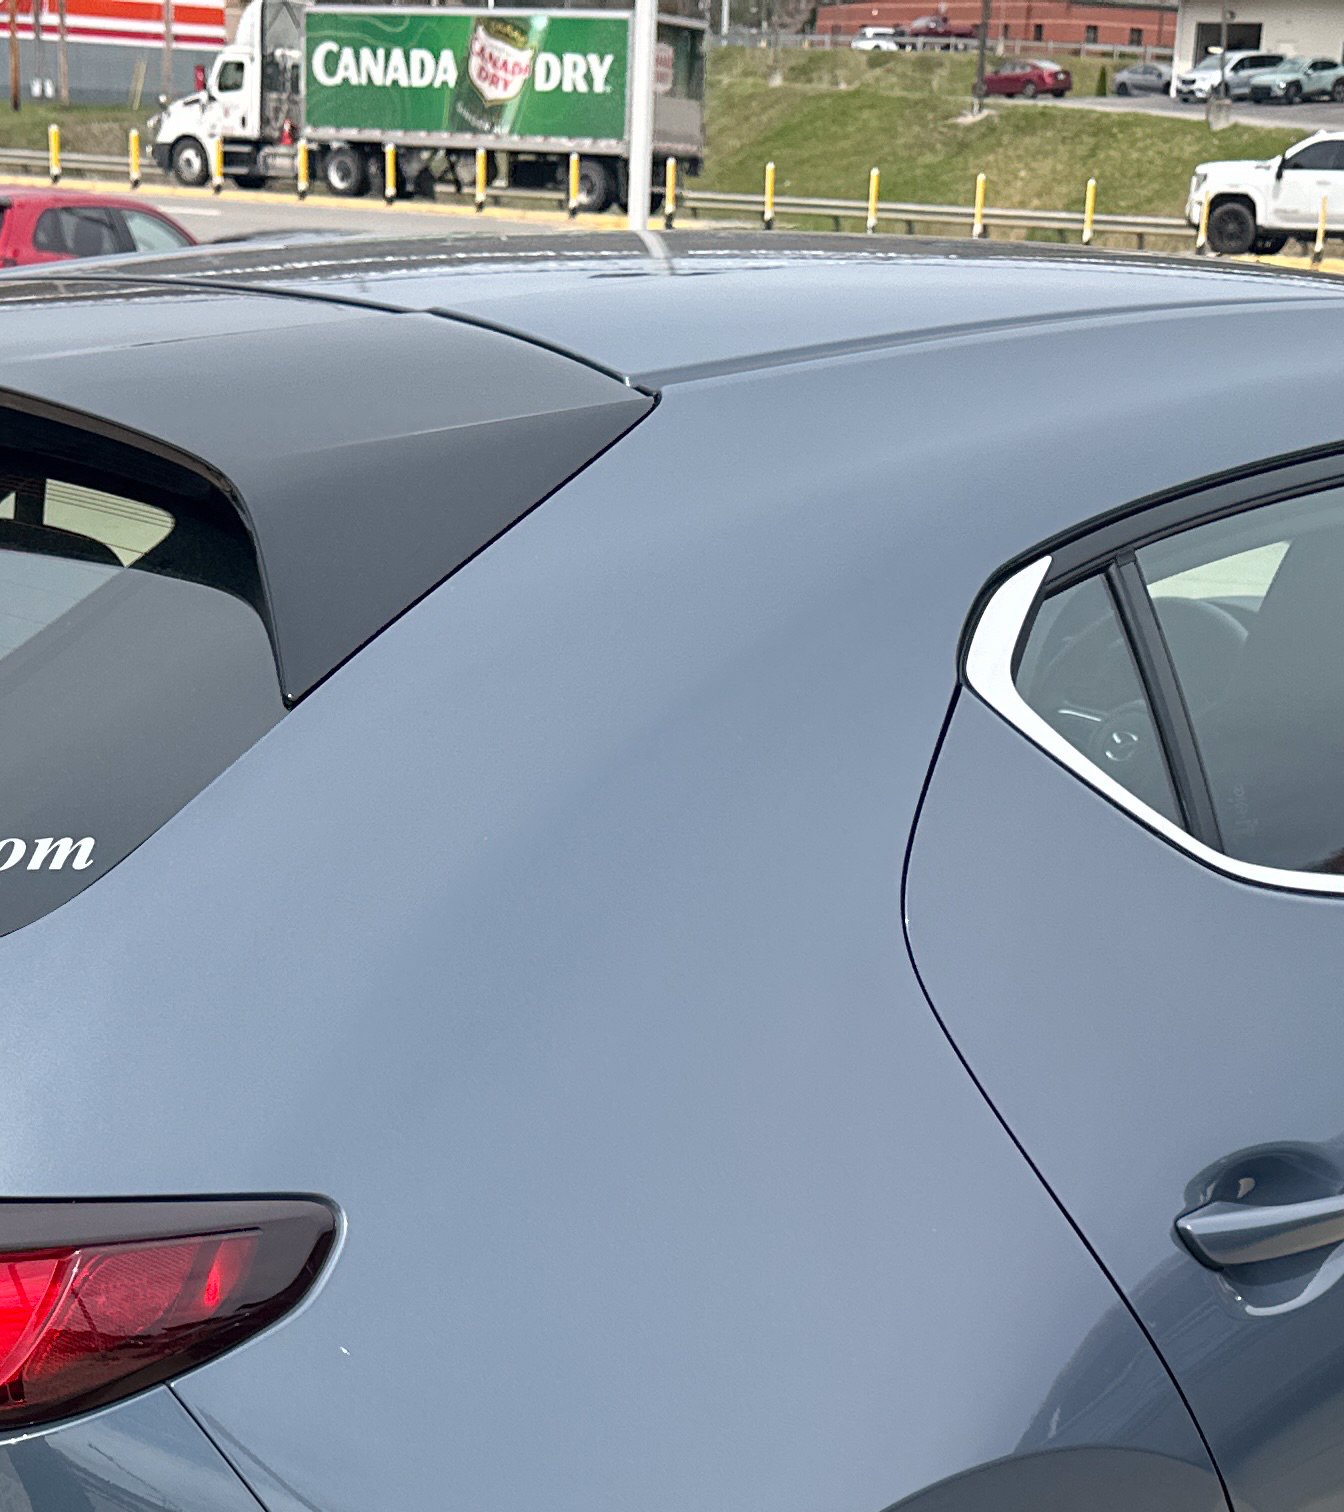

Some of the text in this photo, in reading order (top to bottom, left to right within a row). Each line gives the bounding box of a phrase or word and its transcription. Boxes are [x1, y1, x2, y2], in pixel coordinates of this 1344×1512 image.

[312, 41, 458, 89] CANADA
[534, 52, 614, 94] DRY
[479, 66, 514, 92] DRY
